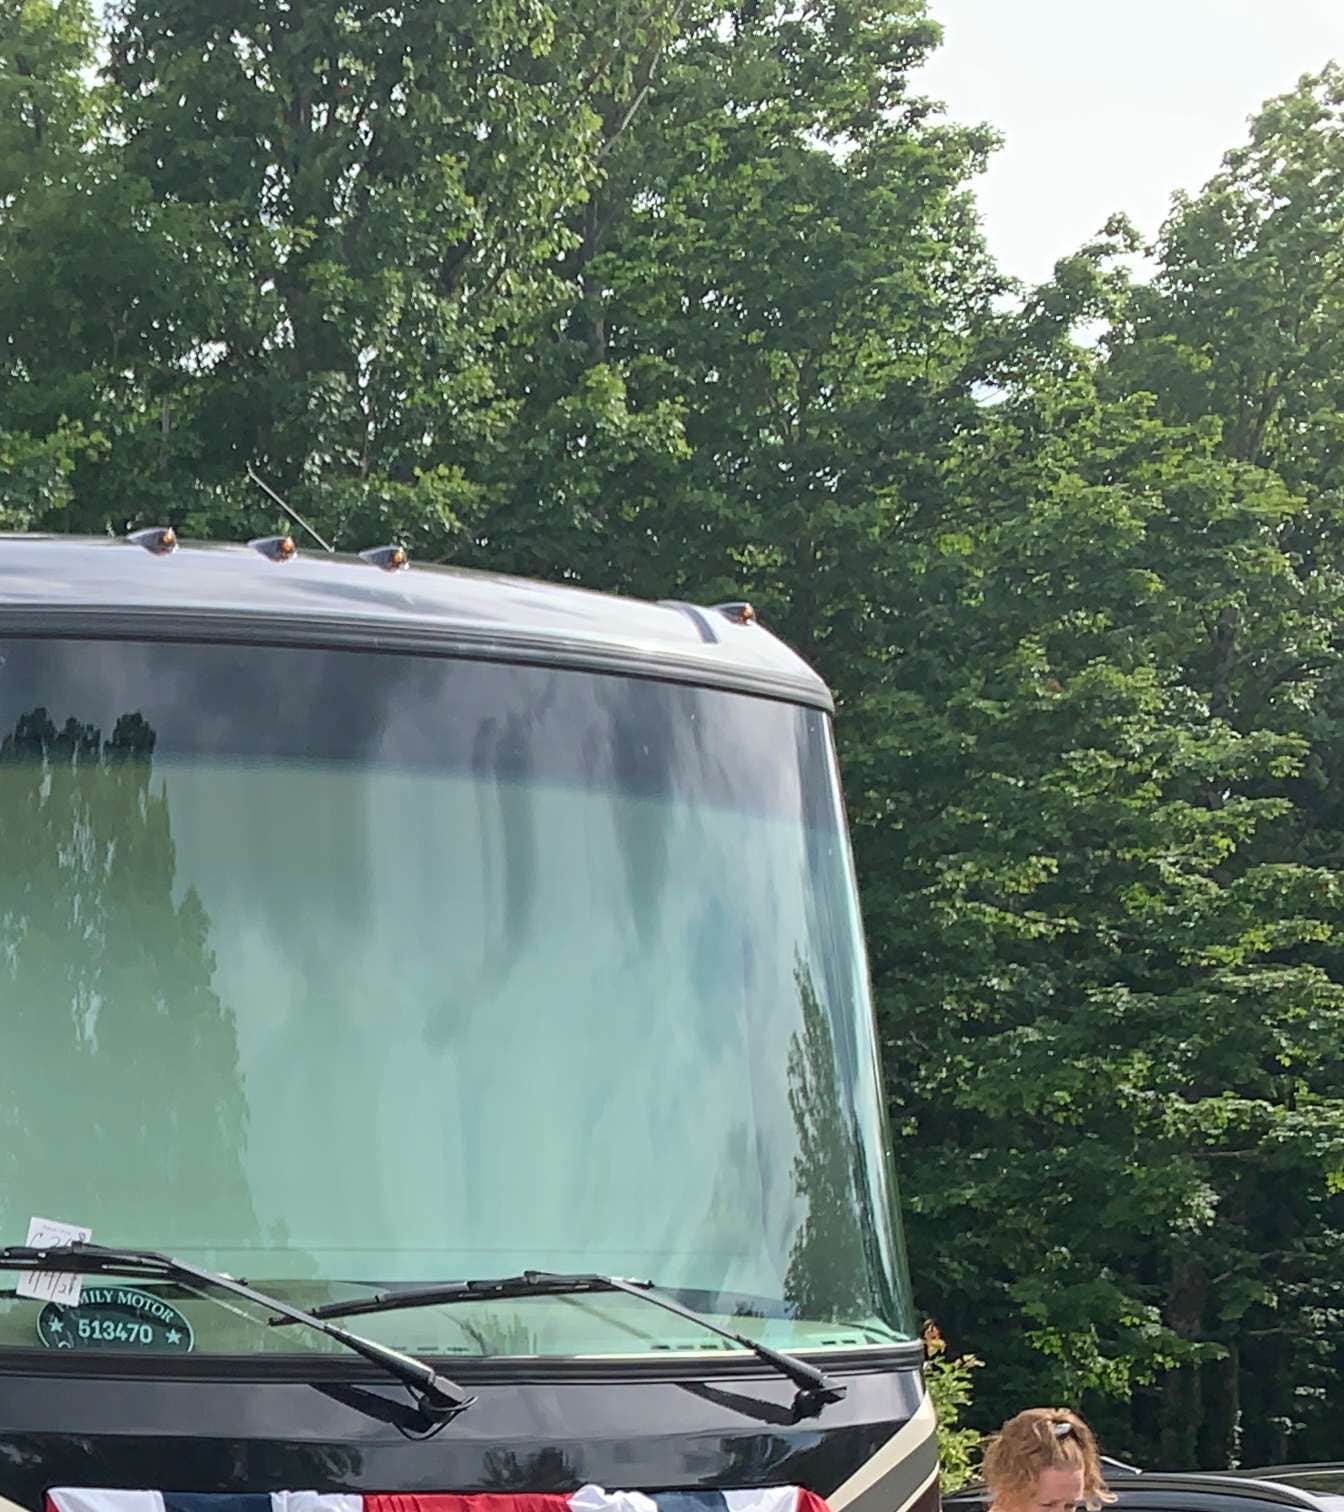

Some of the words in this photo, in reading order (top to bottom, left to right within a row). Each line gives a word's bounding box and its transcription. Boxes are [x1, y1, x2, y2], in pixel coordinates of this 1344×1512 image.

[80, 1289, 113, 1305] MILY
[118, 1291, 174, 1323] MOTOR
[78, 1319, 153, 1344] 513470
